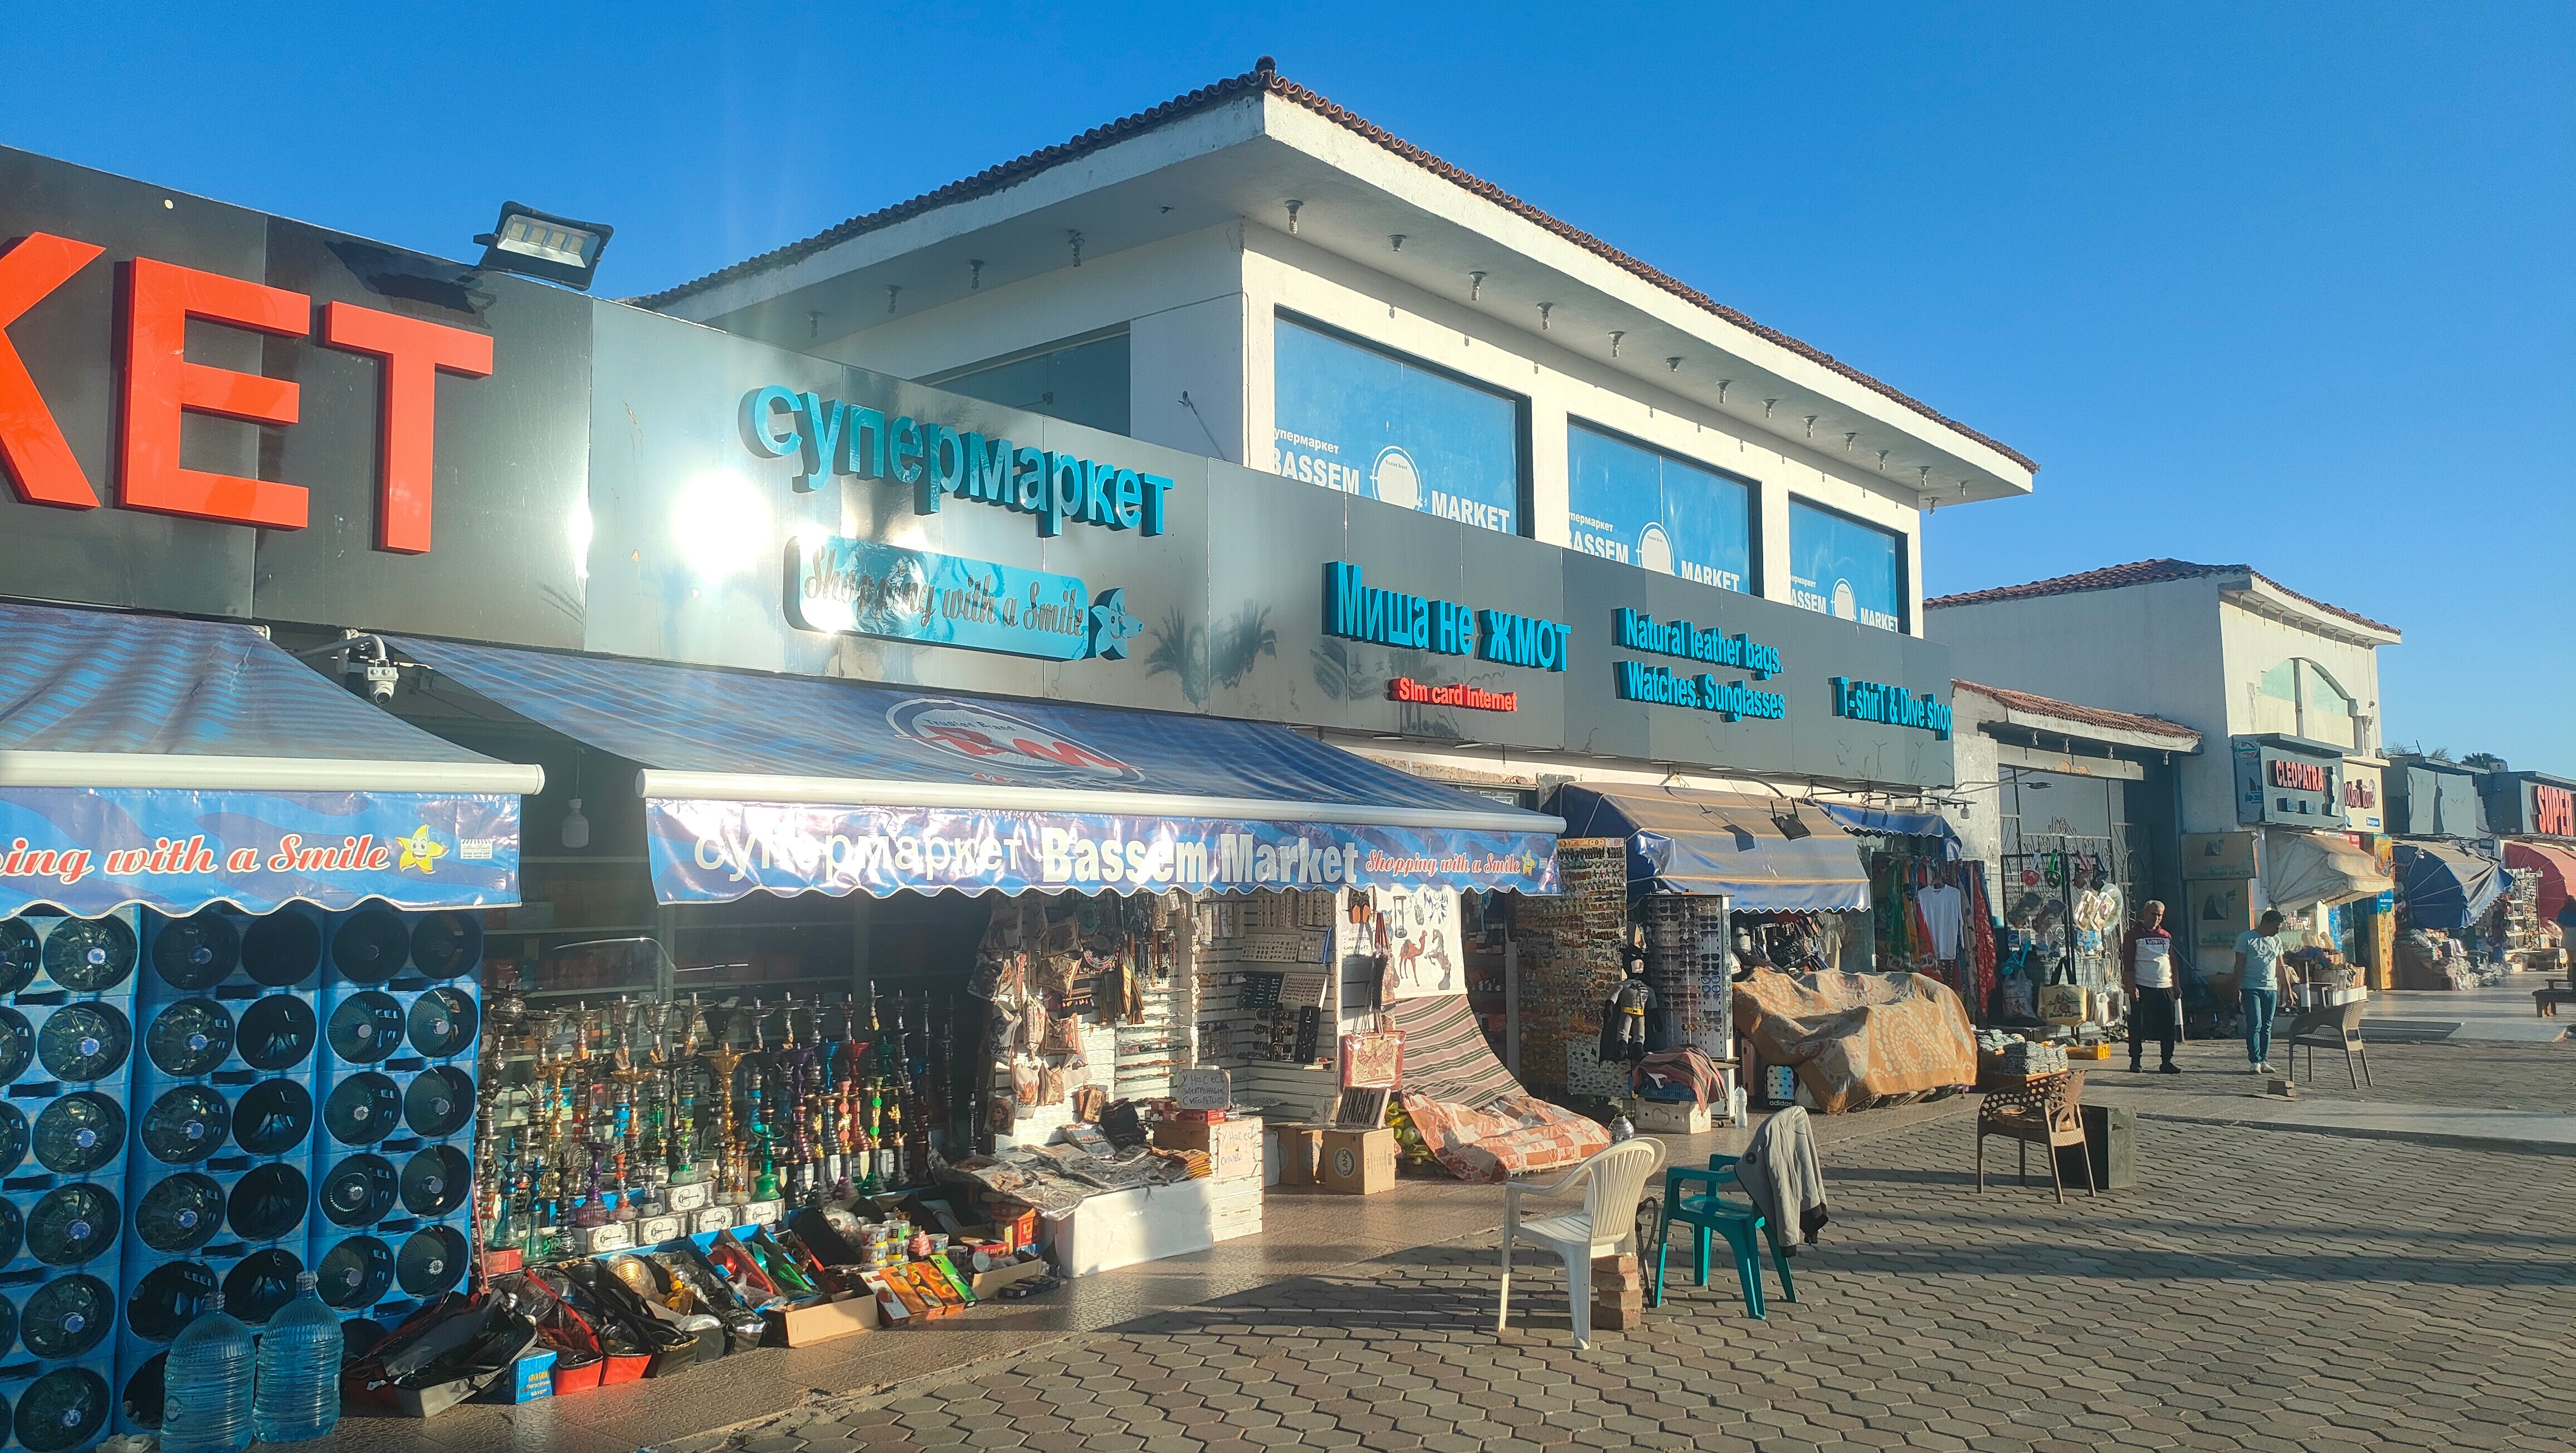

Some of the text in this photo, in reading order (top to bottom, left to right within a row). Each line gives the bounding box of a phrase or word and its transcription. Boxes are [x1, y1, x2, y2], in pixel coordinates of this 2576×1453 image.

[744, 384, 1174, 537] супермаркет
[1431, 490, 1510, 533] MARKET
[1569, 530, 1740, 592] ASSEM MARKET
[804, 547, 1084, 637] Shopping with a Smile
[1334, 560, 1571, 672] Миша не ЖМОТ
[1624, 607, 1686, 656] Natural
[1689, 621, 1741, 666] leather
[1398, 677, 1519, 713] Sim card internet
[1705, 672, 1786, 723] Sunglasses
[1889, 685, 1898, 724] &
[1899, 687, 1925, 727] Dive
[1926, 693, 1953, 741] shop
[923, 719, 1017, 732] Trusted Brand
[2275, 759, 2324, 792] CLEOPATRA
[2537, 784, 2574, 837] SUPER
[0, 833, 392, 885] ing with a Smile
[1041, 826, 1208, 884] Bassem
[1219, 833, 1358, 883] Market
[1365, 849, 1438, 877] Shopping
[1440, 852, 1470, 874] with
[1471, 859, 1482, 874] a
[1483, 852, 1521, 874] Smile
[990, 1044, 1012, 1054] Egypt
